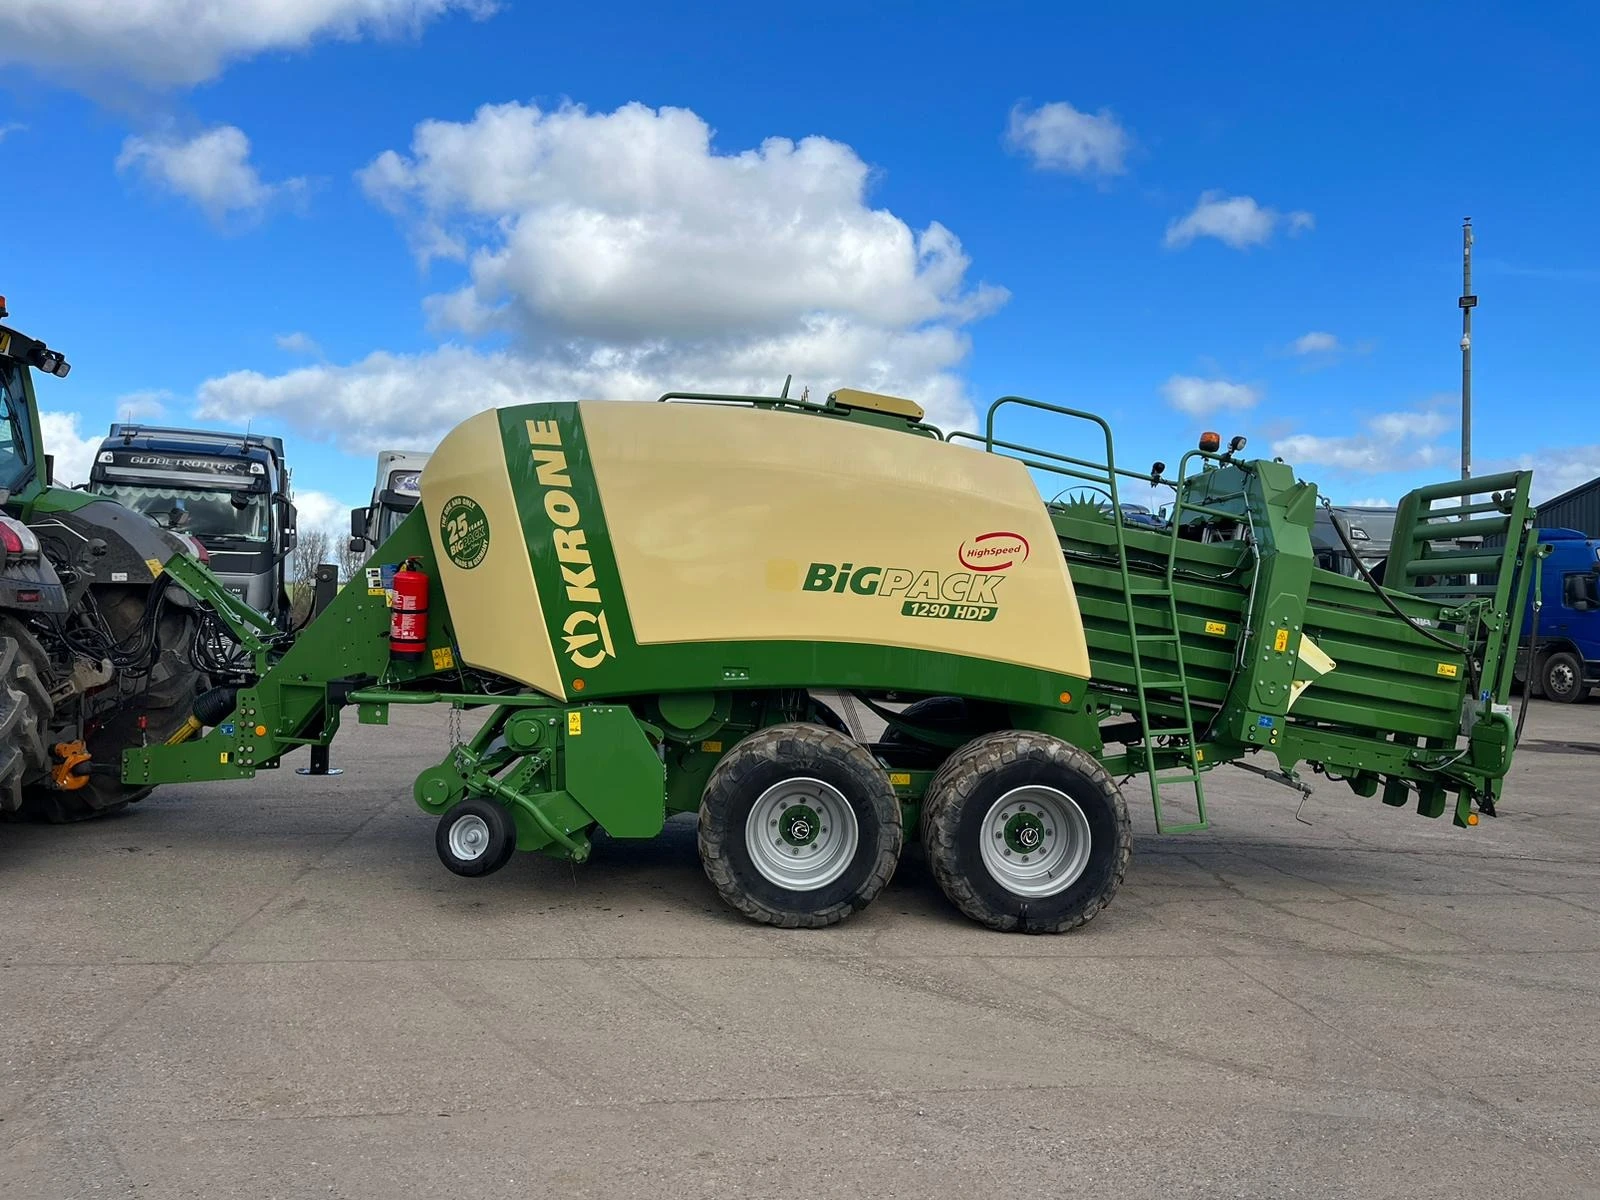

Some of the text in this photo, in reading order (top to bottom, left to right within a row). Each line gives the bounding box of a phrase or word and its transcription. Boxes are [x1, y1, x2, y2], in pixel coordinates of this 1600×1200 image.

[130, 456, 235, 470] GLOBETROTTER
[525, 420, 601, 602] KRONE
[447, 513, 468, 545] 25
[967, 545, 1021, 558] HighSpeed
[910, 603, 990, 621] 1290 HDP
